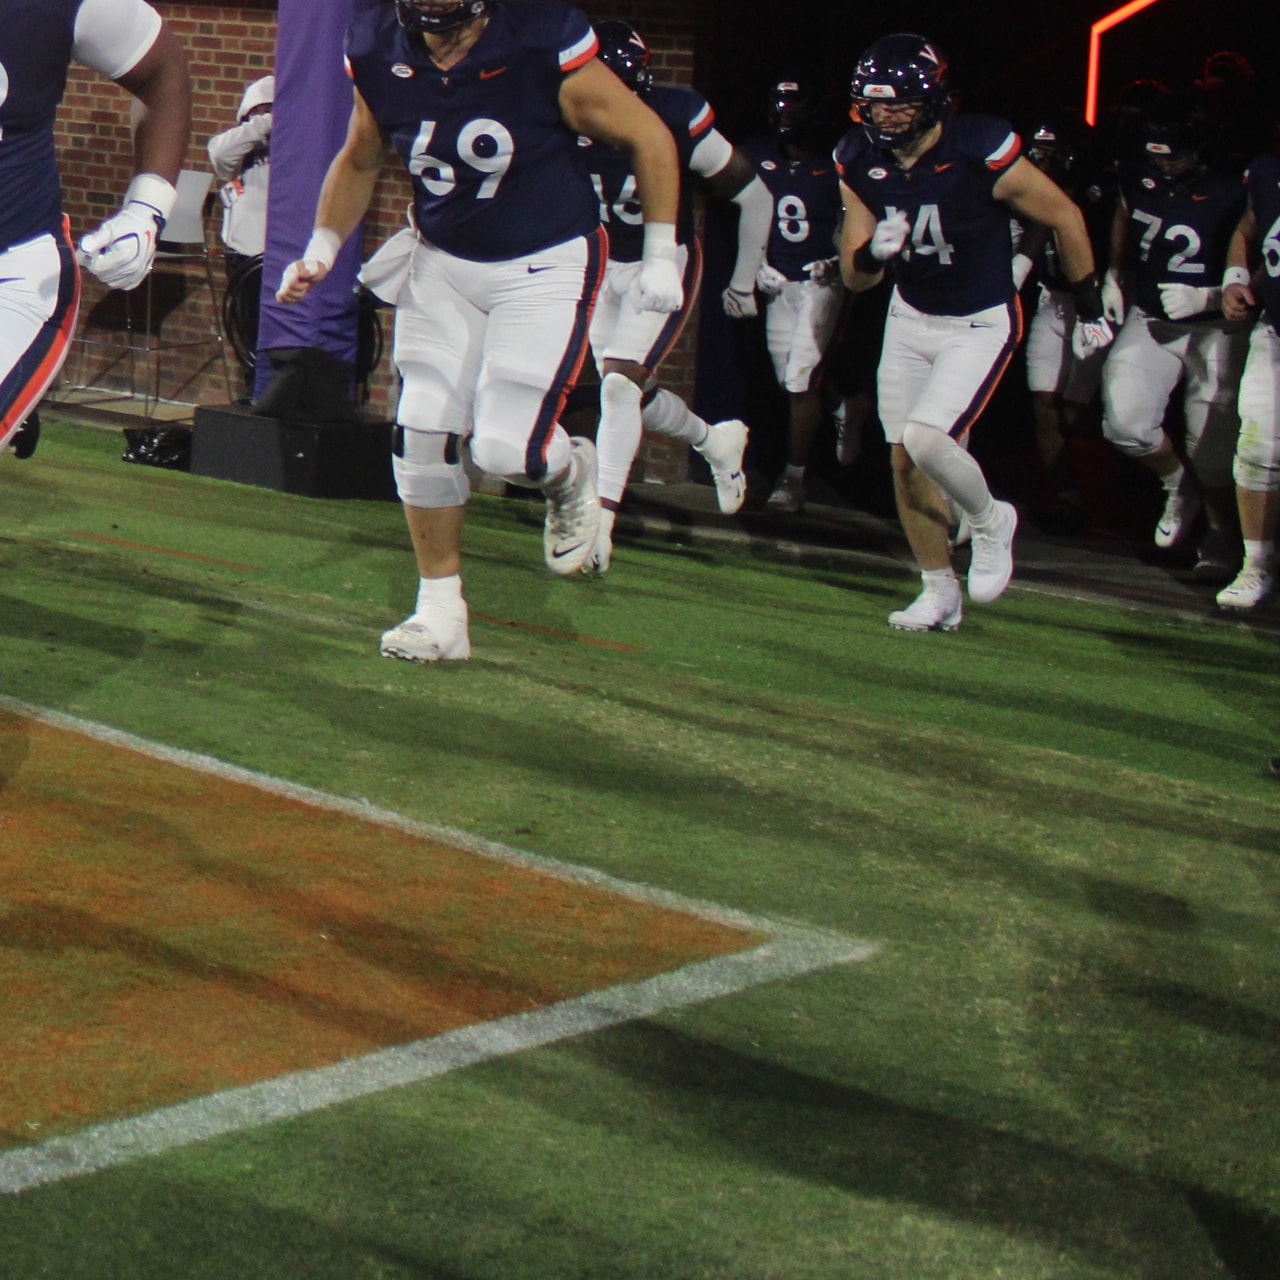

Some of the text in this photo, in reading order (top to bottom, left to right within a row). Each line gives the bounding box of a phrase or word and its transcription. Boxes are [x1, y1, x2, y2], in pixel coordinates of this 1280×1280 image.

[409, 118, 515, 199] 69
[776, 194, 810, 243] 8
[1131, 208, 1206, 274] 72
